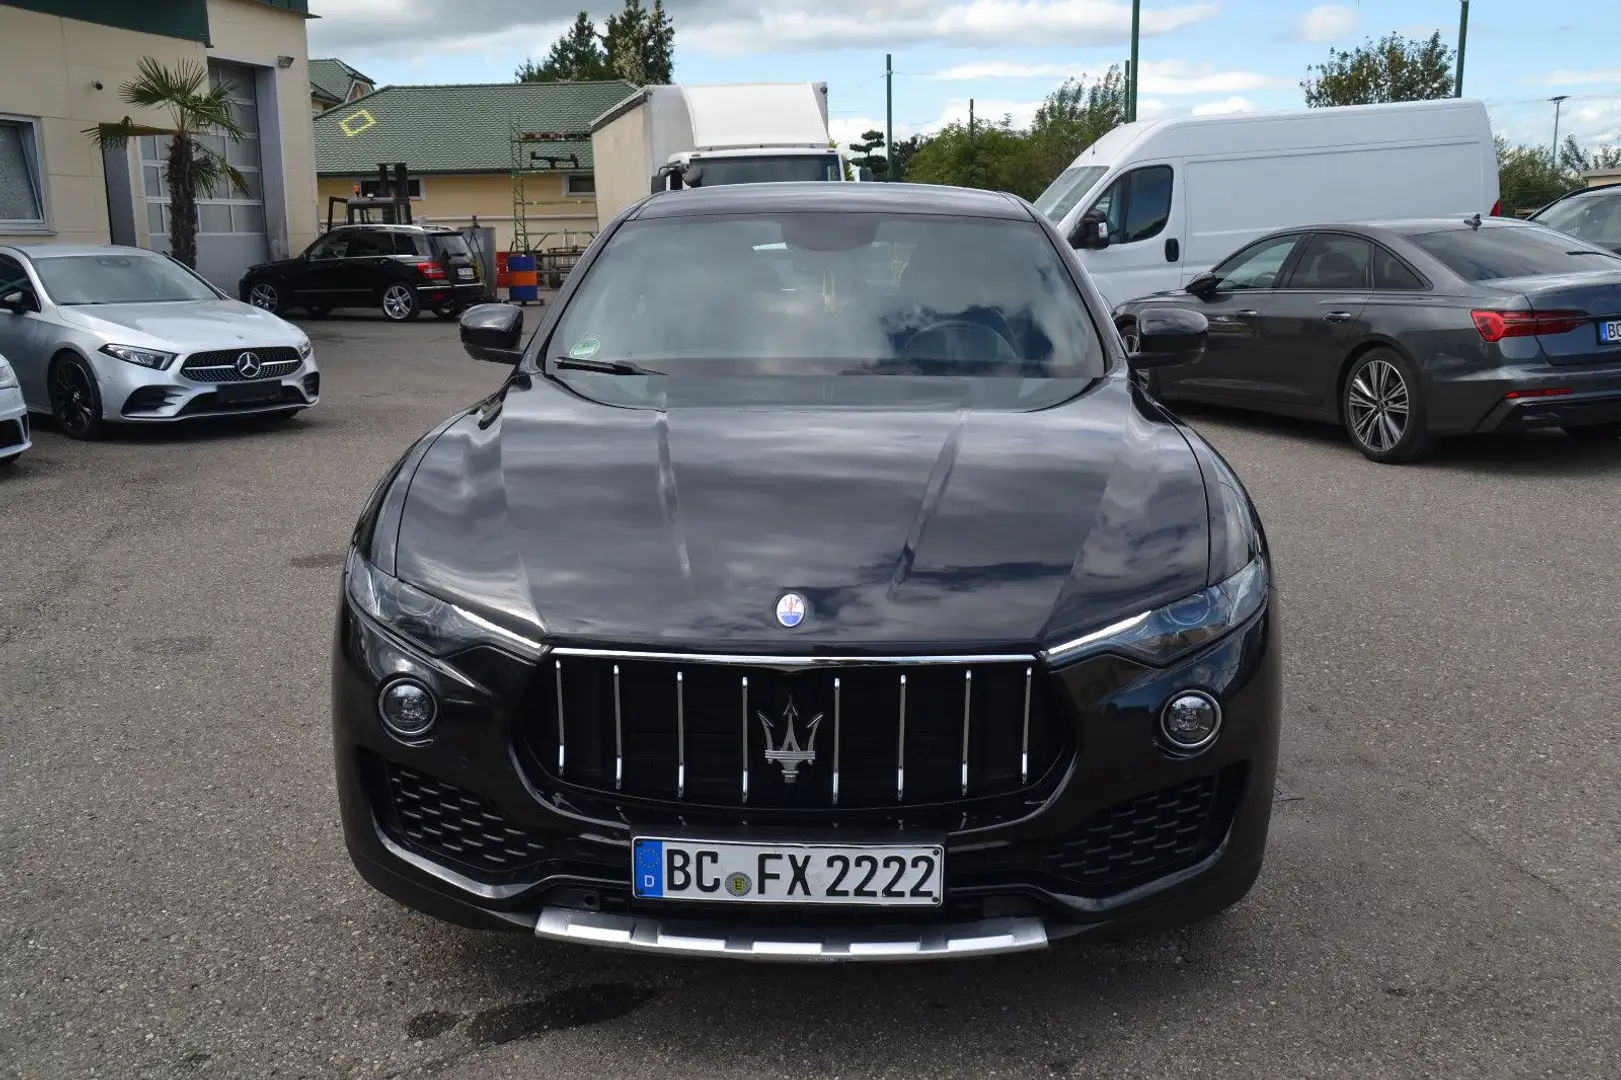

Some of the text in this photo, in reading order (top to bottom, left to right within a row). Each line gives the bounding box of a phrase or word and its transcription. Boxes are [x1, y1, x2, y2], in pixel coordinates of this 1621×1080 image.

[644, 874, 655, 888] D
[666, 848, 935, 898] BC FX 2222
